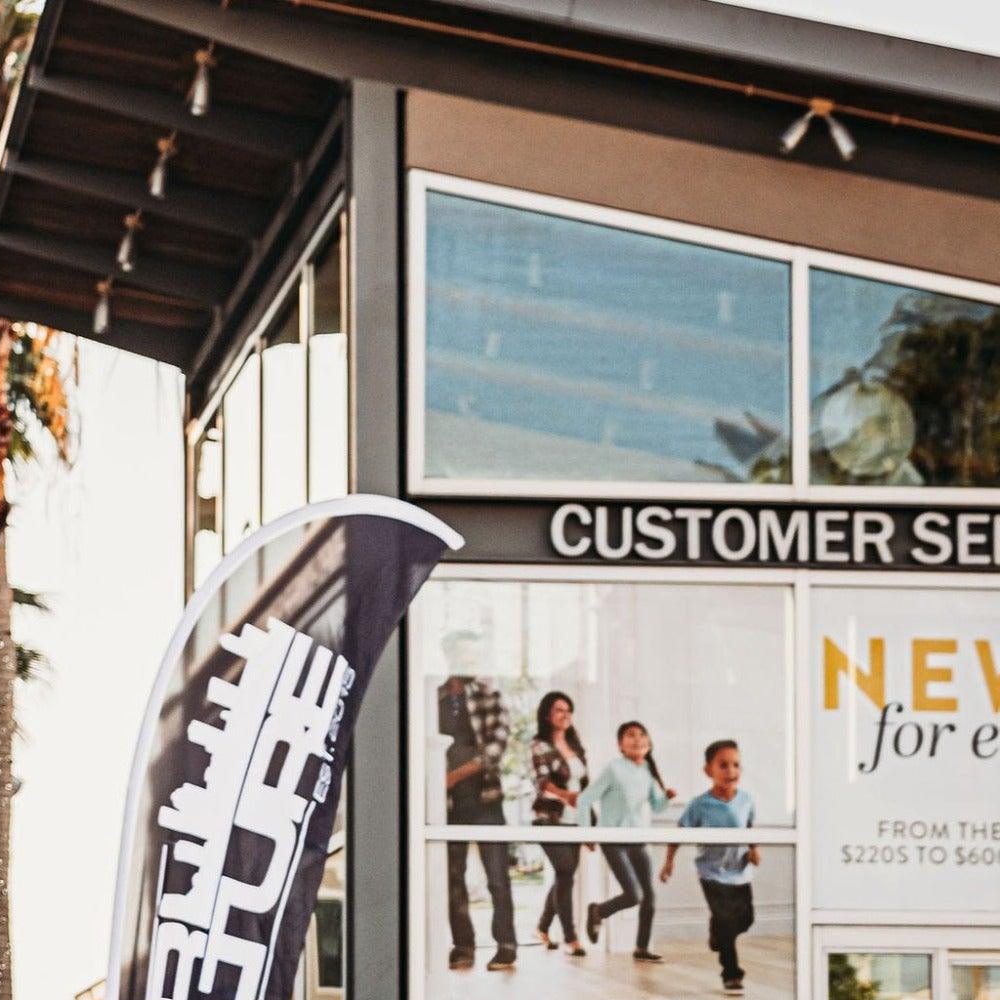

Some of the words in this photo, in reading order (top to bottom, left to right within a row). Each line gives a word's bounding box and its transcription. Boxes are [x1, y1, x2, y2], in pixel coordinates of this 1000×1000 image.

[550, 503, 895, 563] CUSTOMER
[911, 512, 1000, 565] SE
[857, 701, 956, 774] for
[877, 820, 950, 840] FROM
[957, 821, 1000, 841] THE
[916, 845, 948, 865] TO
[954, 845, 1000, 866] $60
